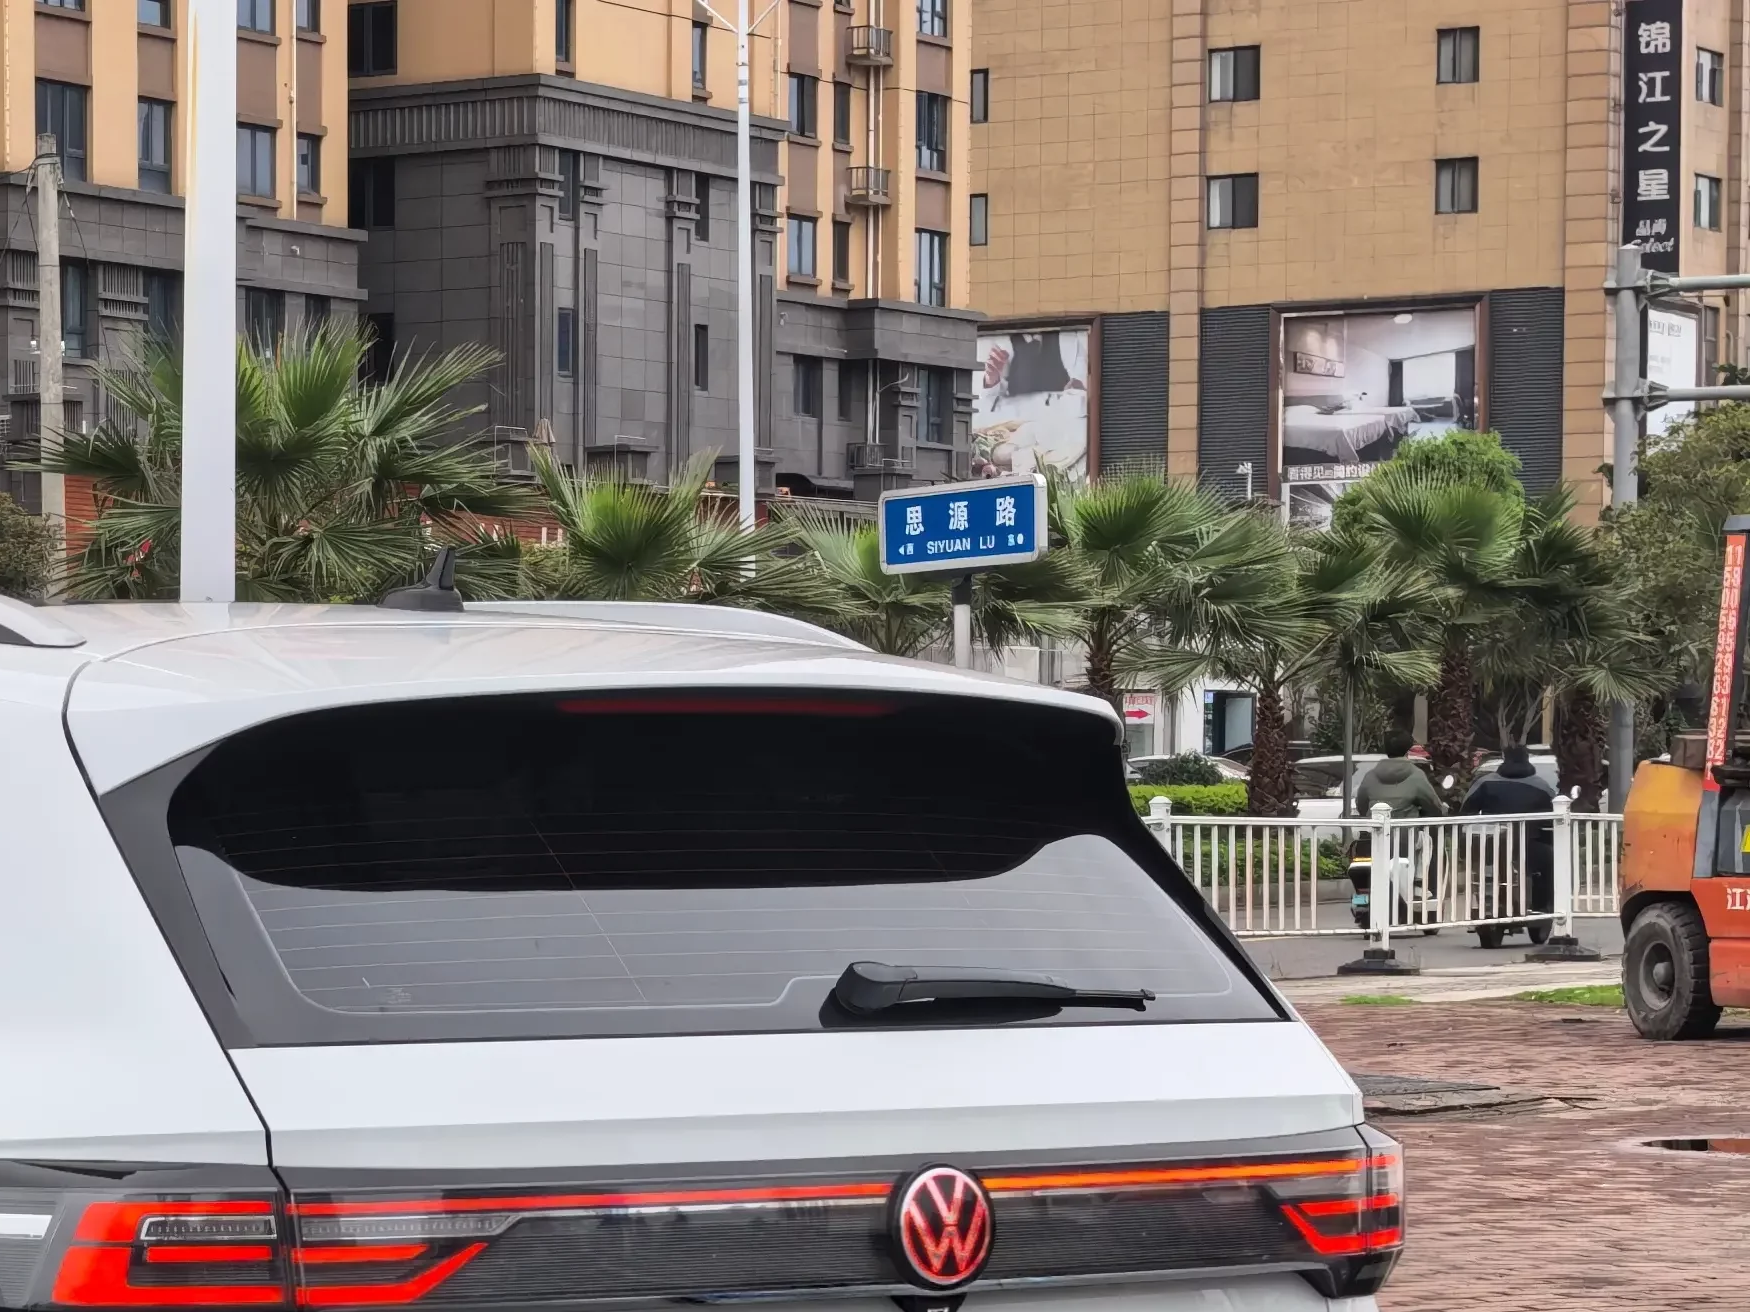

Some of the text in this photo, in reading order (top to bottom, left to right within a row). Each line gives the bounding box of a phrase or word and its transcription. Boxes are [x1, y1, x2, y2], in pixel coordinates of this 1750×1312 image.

[1637, 21, 1671, 201] 锦江之星
[905, 495, 1017, 536] 思源路
[926, 534, 995, 556] SIYUAN LU
